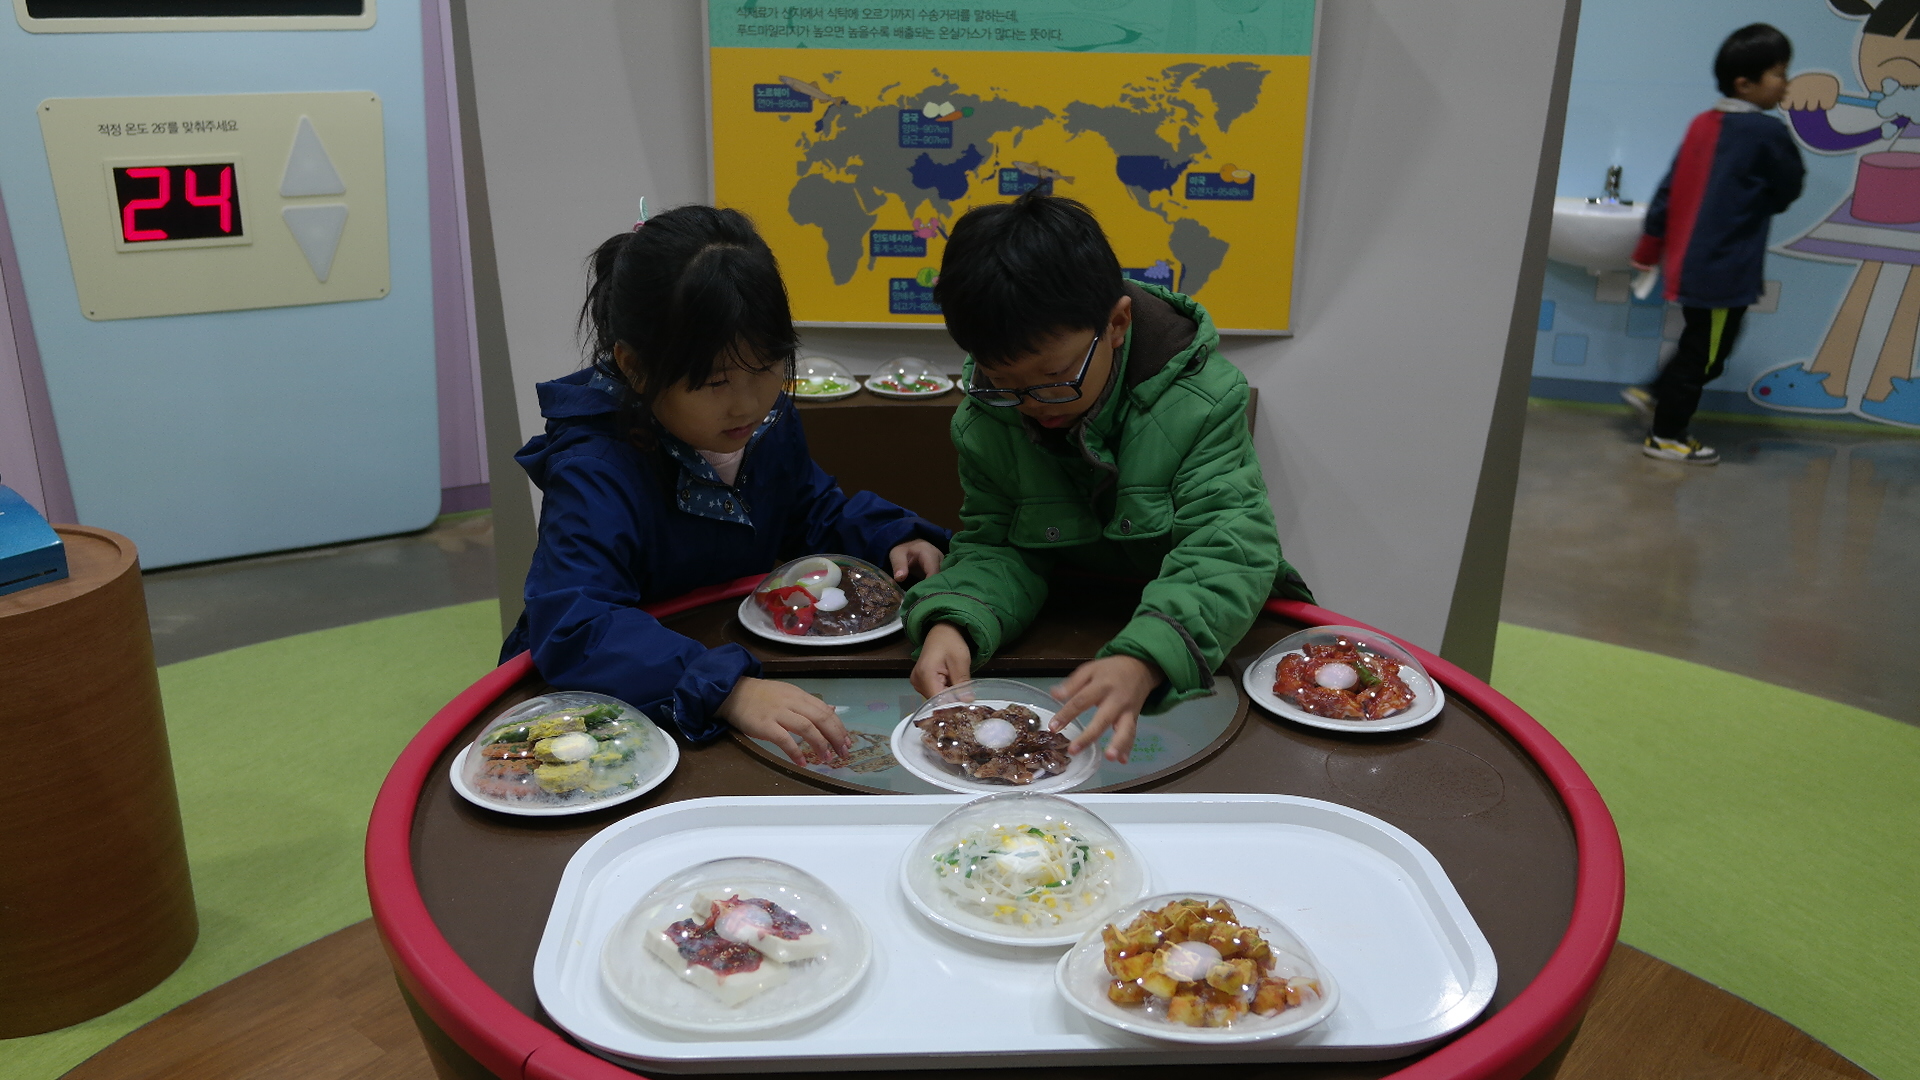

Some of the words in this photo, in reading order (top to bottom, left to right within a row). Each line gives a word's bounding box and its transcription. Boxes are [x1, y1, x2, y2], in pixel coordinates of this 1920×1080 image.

[737, 6, 778, 19] 식재료가
[782, 6, 823, 20] 산지에서
[827, 7, 858, 20] 식탁에
[862, 8, 915, 20] 오르기까지
[918, 9, 970, 22] 수송거리를
[737, 24, 809, 38] 푸드마일리지가
[813, 25, 844, 39] 높으면
[848, 25, 890, 39] 높을수록
[894, 26, 935, 40] 배출되는
[938, 26, 992, 40] 온실가스가
[995, 28, 1026, 41] 많다는
[1030, 28, 1063, 41] 뜻이다.
[757, 88, 790, 98] 노르웨이
[902, 112, 919, 123] 중국
[98, 122, 122, 137] 적정
[125, 122, 149, 136] 온도
[182, 119, 239, 134] 맞춰주세요
[1001, 171, 1018, 182] 일본
[1189, 175, 1206, 185] 미국
[123, 165, 232, 241] 24
[872, 233, 913, 243] 인도네시아
[893, 281, 908, 291] 호주
